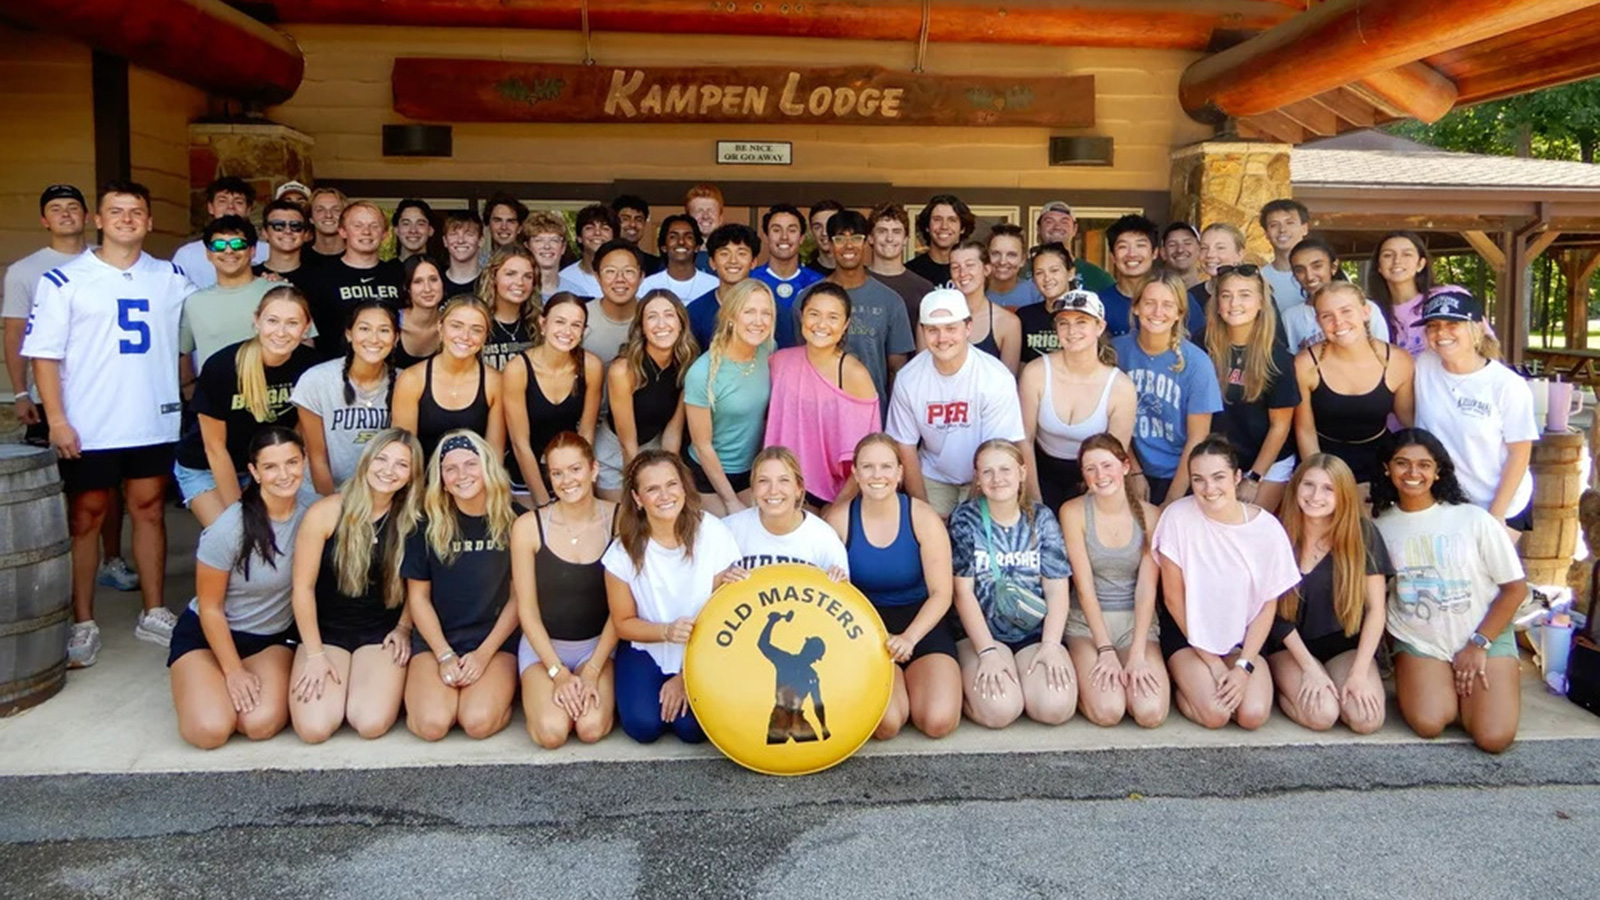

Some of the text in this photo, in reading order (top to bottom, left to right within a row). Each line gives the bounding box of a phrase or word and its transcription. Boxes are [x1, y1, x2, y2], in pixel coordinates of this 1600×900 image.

[604, 69, 904, 118] KAMPEN LODGE
[724, 153, 784, 162] OR GO AWAY
[735, 144, 773, 152] BE NICE
[340, 285, 399, 300] BOILER
[117, 299, 151, 354] 5
[1134, 415, 1174, 442] ONS
[716, 586, 864, 648] OLD MASTERS
